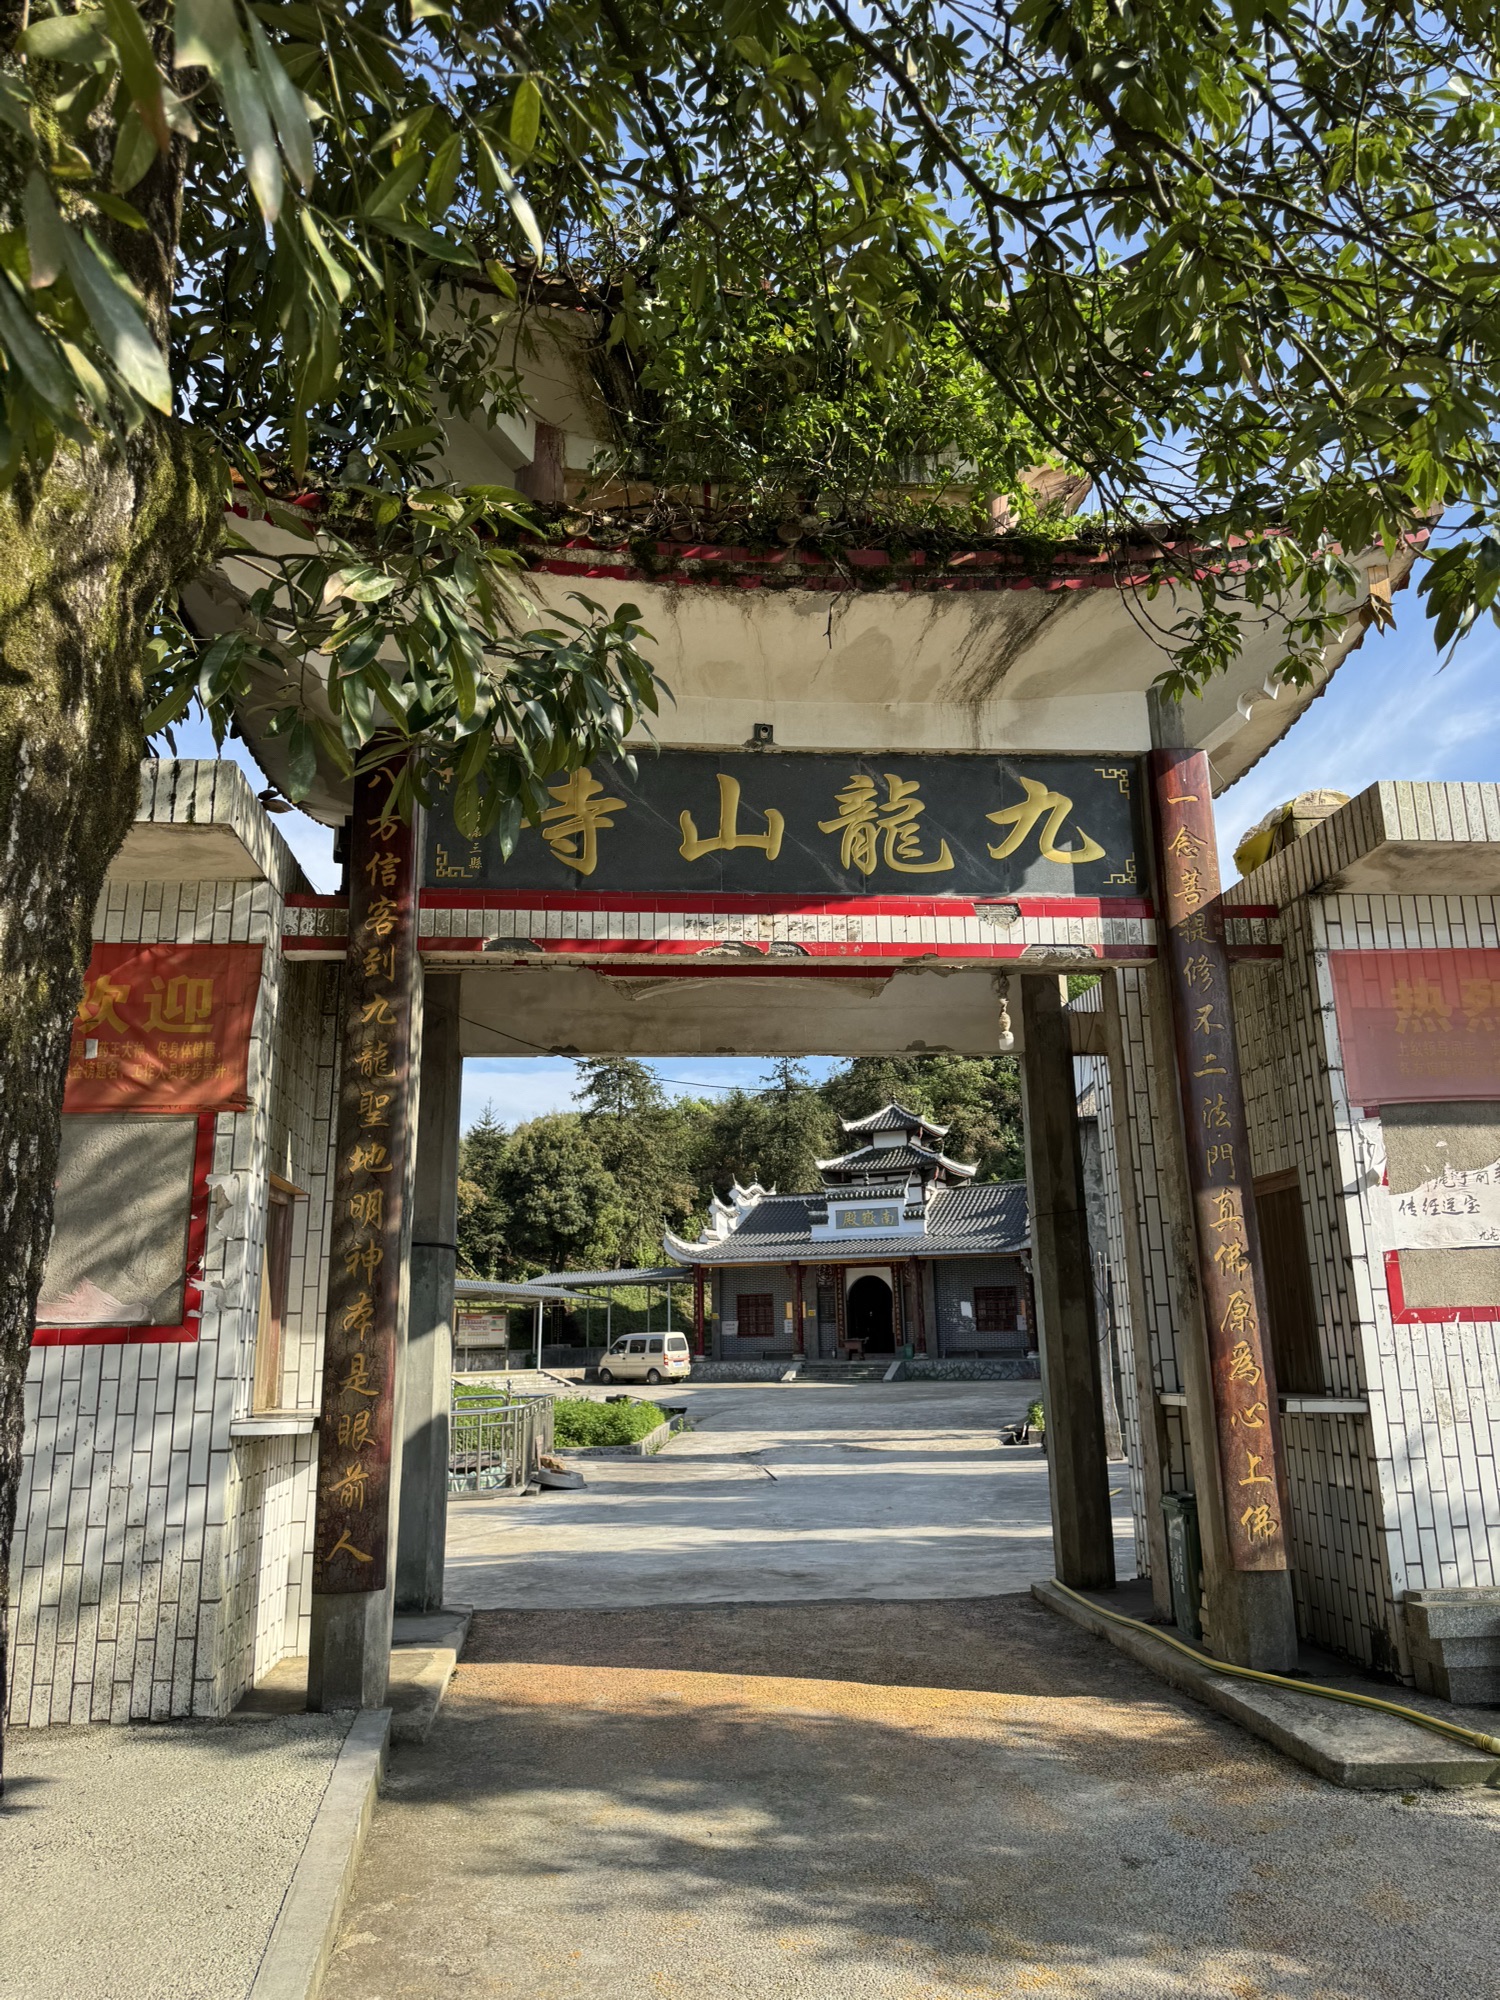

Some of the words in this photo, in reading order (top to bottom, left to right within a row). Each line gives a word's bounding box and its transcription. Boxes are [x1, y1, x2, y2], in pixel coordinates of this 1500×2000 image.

[520, 767, 1106, 877] 九龍山寺
[78, 974, 214, 1034] 欢迎
